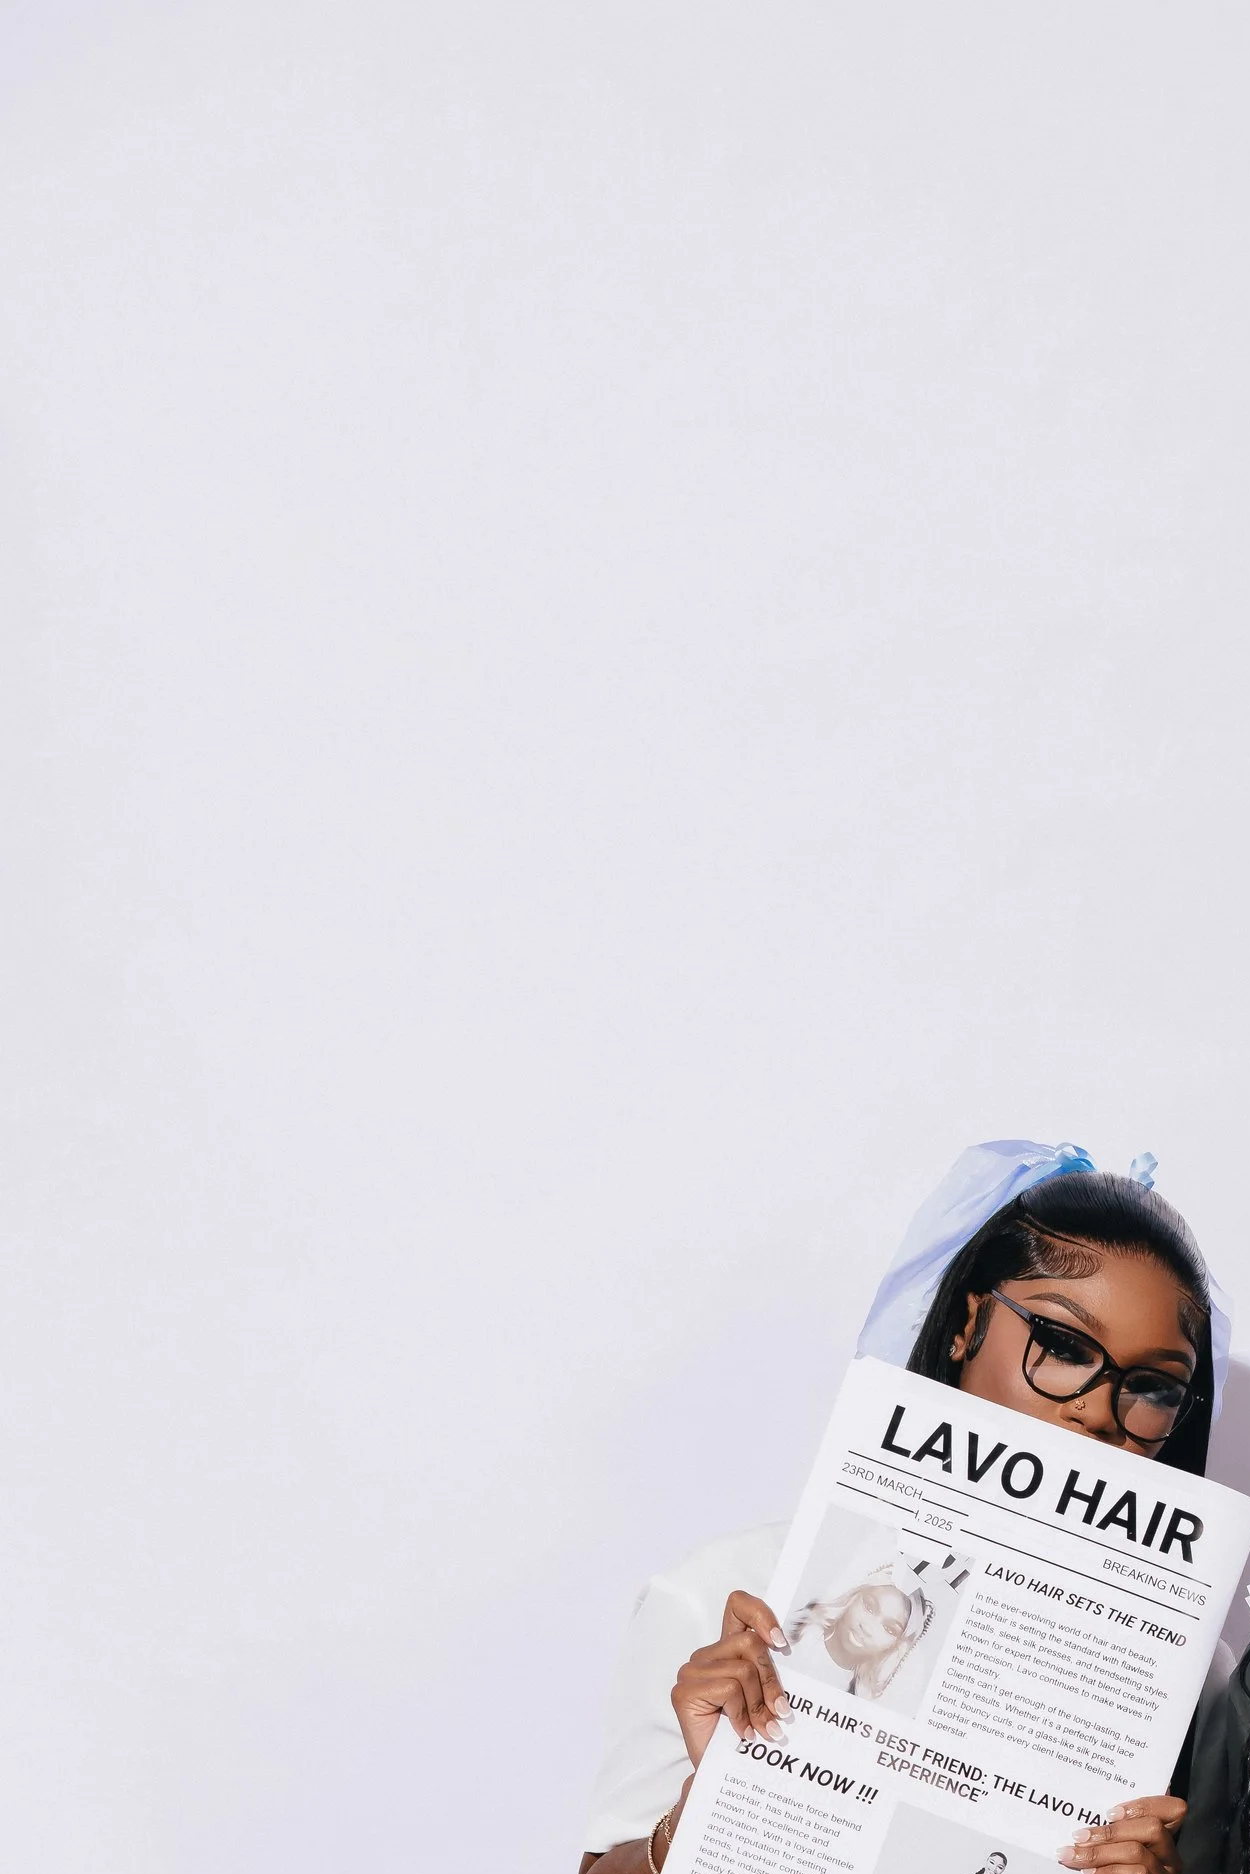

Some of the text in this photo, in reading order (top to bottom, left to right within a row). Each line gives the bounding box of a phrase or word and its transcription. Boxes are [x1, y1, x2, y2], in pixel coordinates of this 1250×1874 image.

[841, 1462, 923, 1499] 23RD MARCH
[881, 1405, 1204, 1564] LAVO HAIR
[924, 1513, 954, 1532] 2025
[984, 1563, 1025, 1586] LAVO
[1026, 1578, 1065, 1601] HAIR
[1065, 1593, 1105, 1616] SETS
[1107, 1607, 1138, 1629] THE
[1139, 1619, 1187, 1647] TREND
[1102, 1558, 1207, 1606] BREAKING NEWS
[970, 1604, 1154, 1680] LavoHair is setting the standard with flawless
[975, 1592, 984, 1601] In
[985, 1596, 999, 1607] the
[1000, 1603, 1057, 1630] ever-evolving
[1058, 1623, 1082, 1637] world
[1082, 1633, 1092, 1641] of
[1092, 1635, 1109, 1647] hair
[1109, 1643, 1128, 1654] and
[998, 1631, 1021, 1644] sleek
[1022, 1639, 1037, 1649] silk
[1075, 1659, 1093, 1670] and
[1093, 1665, 1143, 1691] trendsetting
[799, 1762, 856, 1794] NOW
[855, 1784, 879, 1805] !!!
[875, 1729, 921, 1757] BEST
[922, 1748, 988, 1785] FRIEND:
[993, 1774, 1027, 1799] THE
[1028, 1788, 1074, 1817] LAVO
[715, 1798, 830, 1848] known for excellence and
[751, 1784, 766, 1795] the
[767, 1791, 804, 1810] creative
[806, 1804, 829, 1819] force
[830, 1813, 863, 1832] behind
[765, 1803, 782, 1816] has
[784, 1810, 804, 1824] built
[813, 1821, 841, 1838] brand
